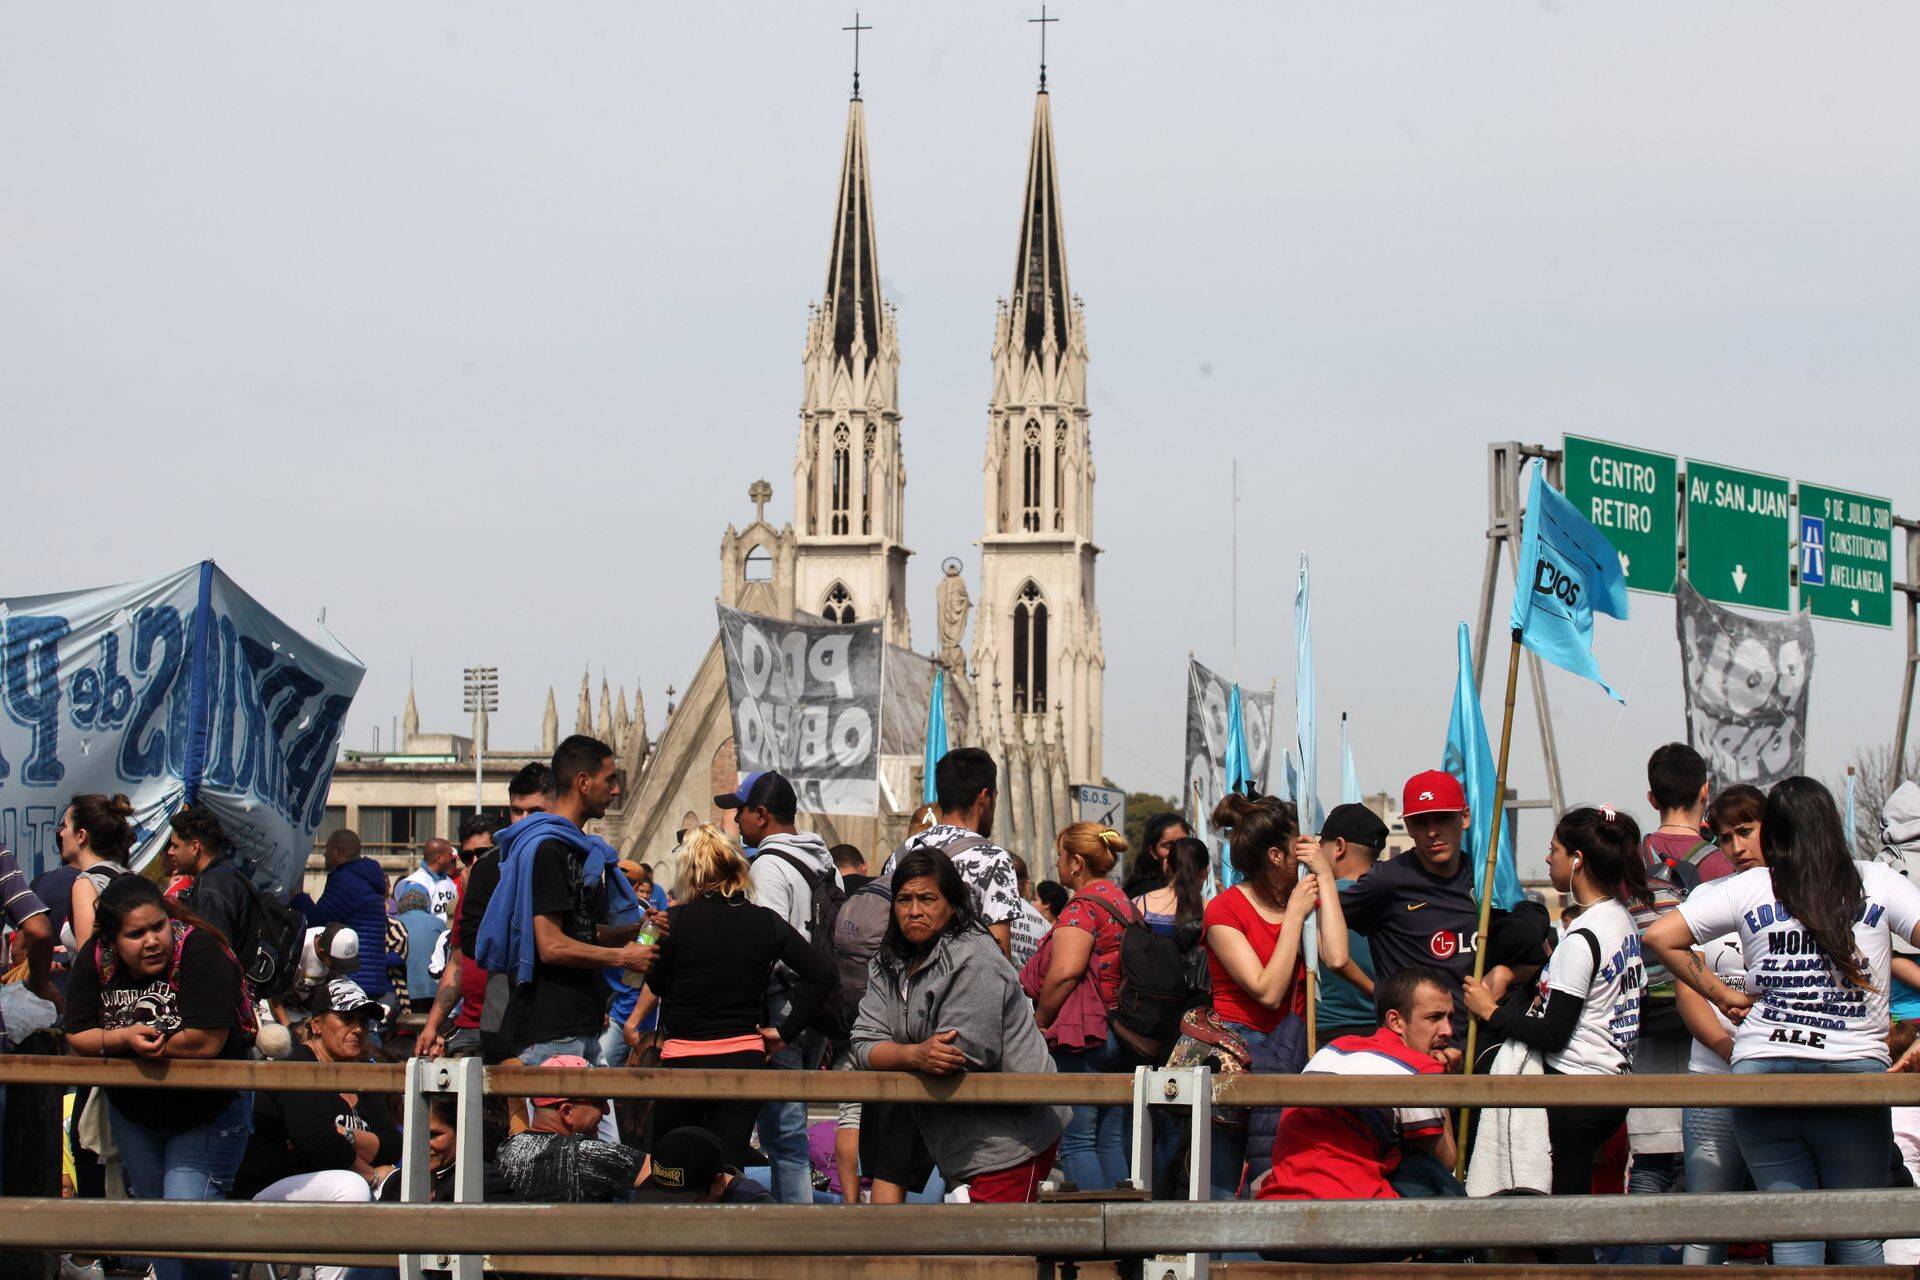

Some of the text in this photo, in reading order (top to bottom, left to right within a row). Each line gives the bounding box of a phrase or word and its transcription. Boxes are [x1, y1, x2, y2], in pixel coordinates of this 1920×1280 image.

[1590, 456, 1656, 494] CENTRO
[1690, 476, 1787, 519] AV. SAN JUAN
[1591, 496, 1652, 534] RETIRO
[1824, 497, 1890, 531] 9 DE JULIO SUR
[1830, 531, 1888, 562] CONSTITUCION
[1830, 564, 1885, 593] AVELLANEDA
[1082, 790, 1112, 806] S.O.S.
[1755, 975, 1837, 988] PODEROSA
[1823, 990, 1865, 1003] USAR
[1761, 1008, 1781, 1022] EL
[1791, 1001, 1867, 1018] CAMBIAR
[1768, 1028, 1827, 1050] ALE
